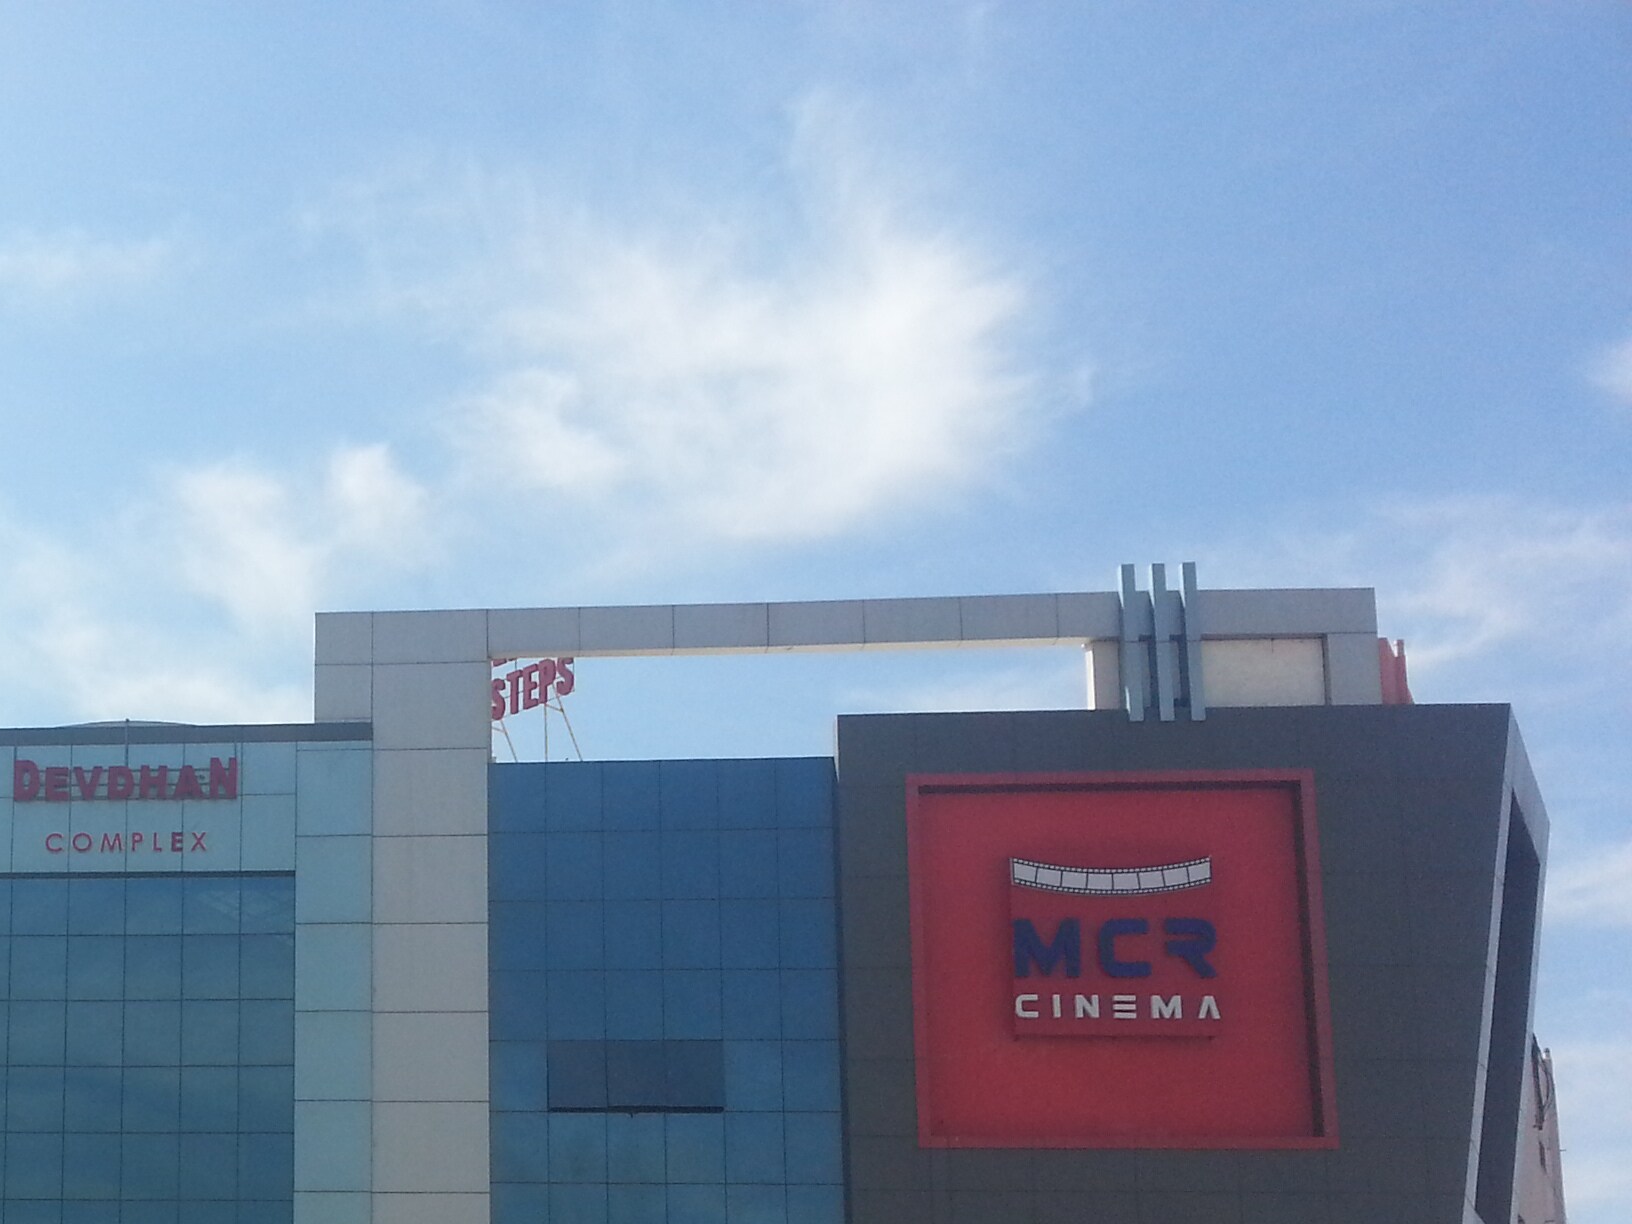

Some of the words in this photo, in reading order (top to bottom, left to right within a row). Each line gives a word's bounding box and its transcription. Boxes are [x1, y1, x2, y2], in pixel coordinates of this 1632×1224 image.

[491, 657, 574, 720] STEPS
[14, 757, 237, 802] DEVDHAN
[45, 831, 207, 852] COMPLEX
[1011, 917, 1217, 978] MCR
[1015, 994, 1221, 1020] CINEMA
